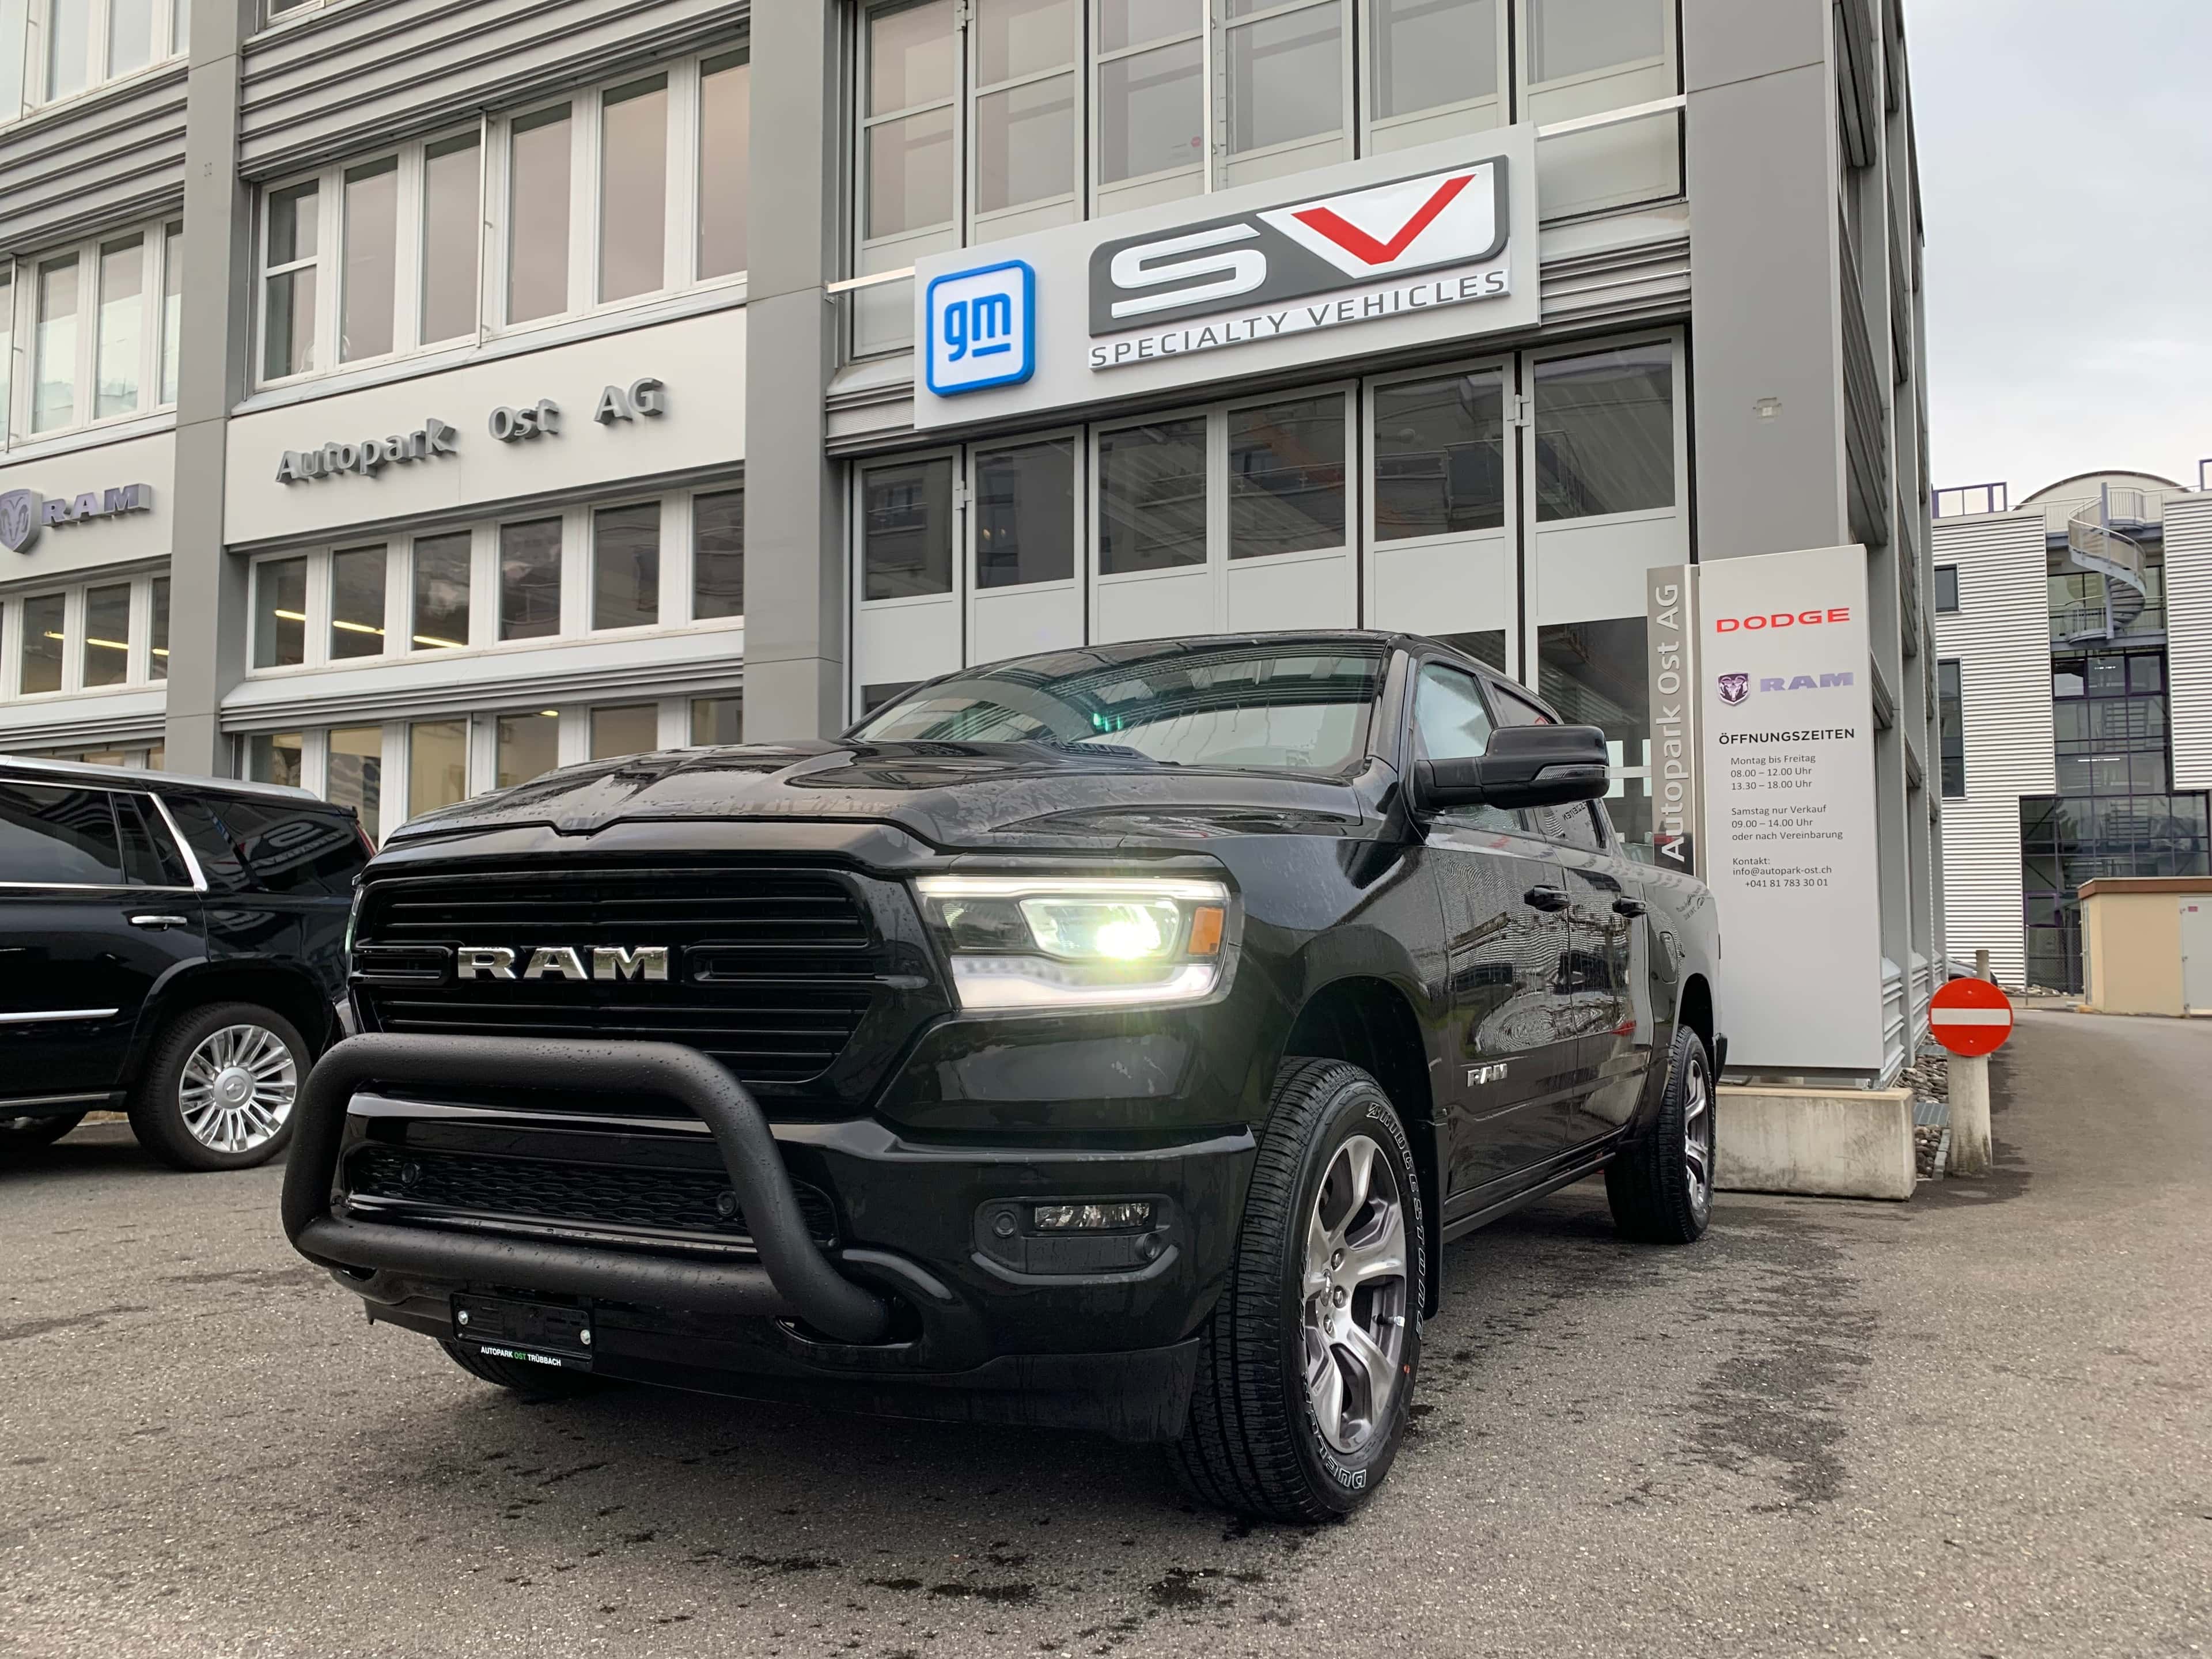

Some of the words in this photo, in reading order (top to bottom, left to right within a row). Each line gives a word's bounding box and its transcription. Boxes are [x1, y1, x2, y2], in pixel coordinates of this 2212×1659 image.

[944, 292, 1010, 362] gm
[1091, 313, 1287, 366] SPECIALTY
[1306, 271, 1505, 327] VEHICLES
[276, 418, 458, 484] Autopark
[488, 398, 559, 442] Ost
[594, 377, 664, 425] AG
[41, 483, 151, 527] RAM
[1655, 584, 1679, 631] AG
[1716, 608, 1850, 632] DODGE
[1657, 641, 1680, 695] Ost
[1760, 672, 1854, 692] RAM
[1718, 728, 1855, 745] ÖFFNUNGSZEITEN
[1730, 756, 1766, 766] Montag
[1768, 755, 1782, 764] bis
[1783, 754, 1816, 763] Freitag
[1730, 769, 1756, 778] 08.00
[1767, 767, 1792, 776] 12.00
[1795, 767, 1812, 775] Uhr
[1656, 704, 1689, 862] Autopark
[1732, 782, 1757, 790] 13.30
[1767, 781, 1793, 789] 18.00
[1795, 779, 1812, 787] Uhr
[1732, 807, 1770, 816] Samstag
[1790, 804, 1827, 813] Verkauf
[1732, 820, 1757, 828] 09.00
[1768, 819, 1793, 827] 14.00
[1732, 832, 1753, 840] oder
[1756, 831, 1777, 839] nach
[1779, 830, 1843, 840] Vereinbarung
[1732, 857, 1770, 865] Kontakt:
[1733, 865, 1832, 876] info@autopark-ost.ch
[1745, 880, 1767, 888] +041
[1770, 879, 1781, 887] 81
[1784, 878, 1800, 887] 783
[1803, 878, 1815, 887] 30
[458, 946, 669, 980] RAM
[1467, 1063, 1508, 1088] RAM
[480, 1346, 513, 1358] AUTOPARK
[514, 1351, 526, 1360] OST
[527, 1354, 562, 1366] TRÜBBACH
